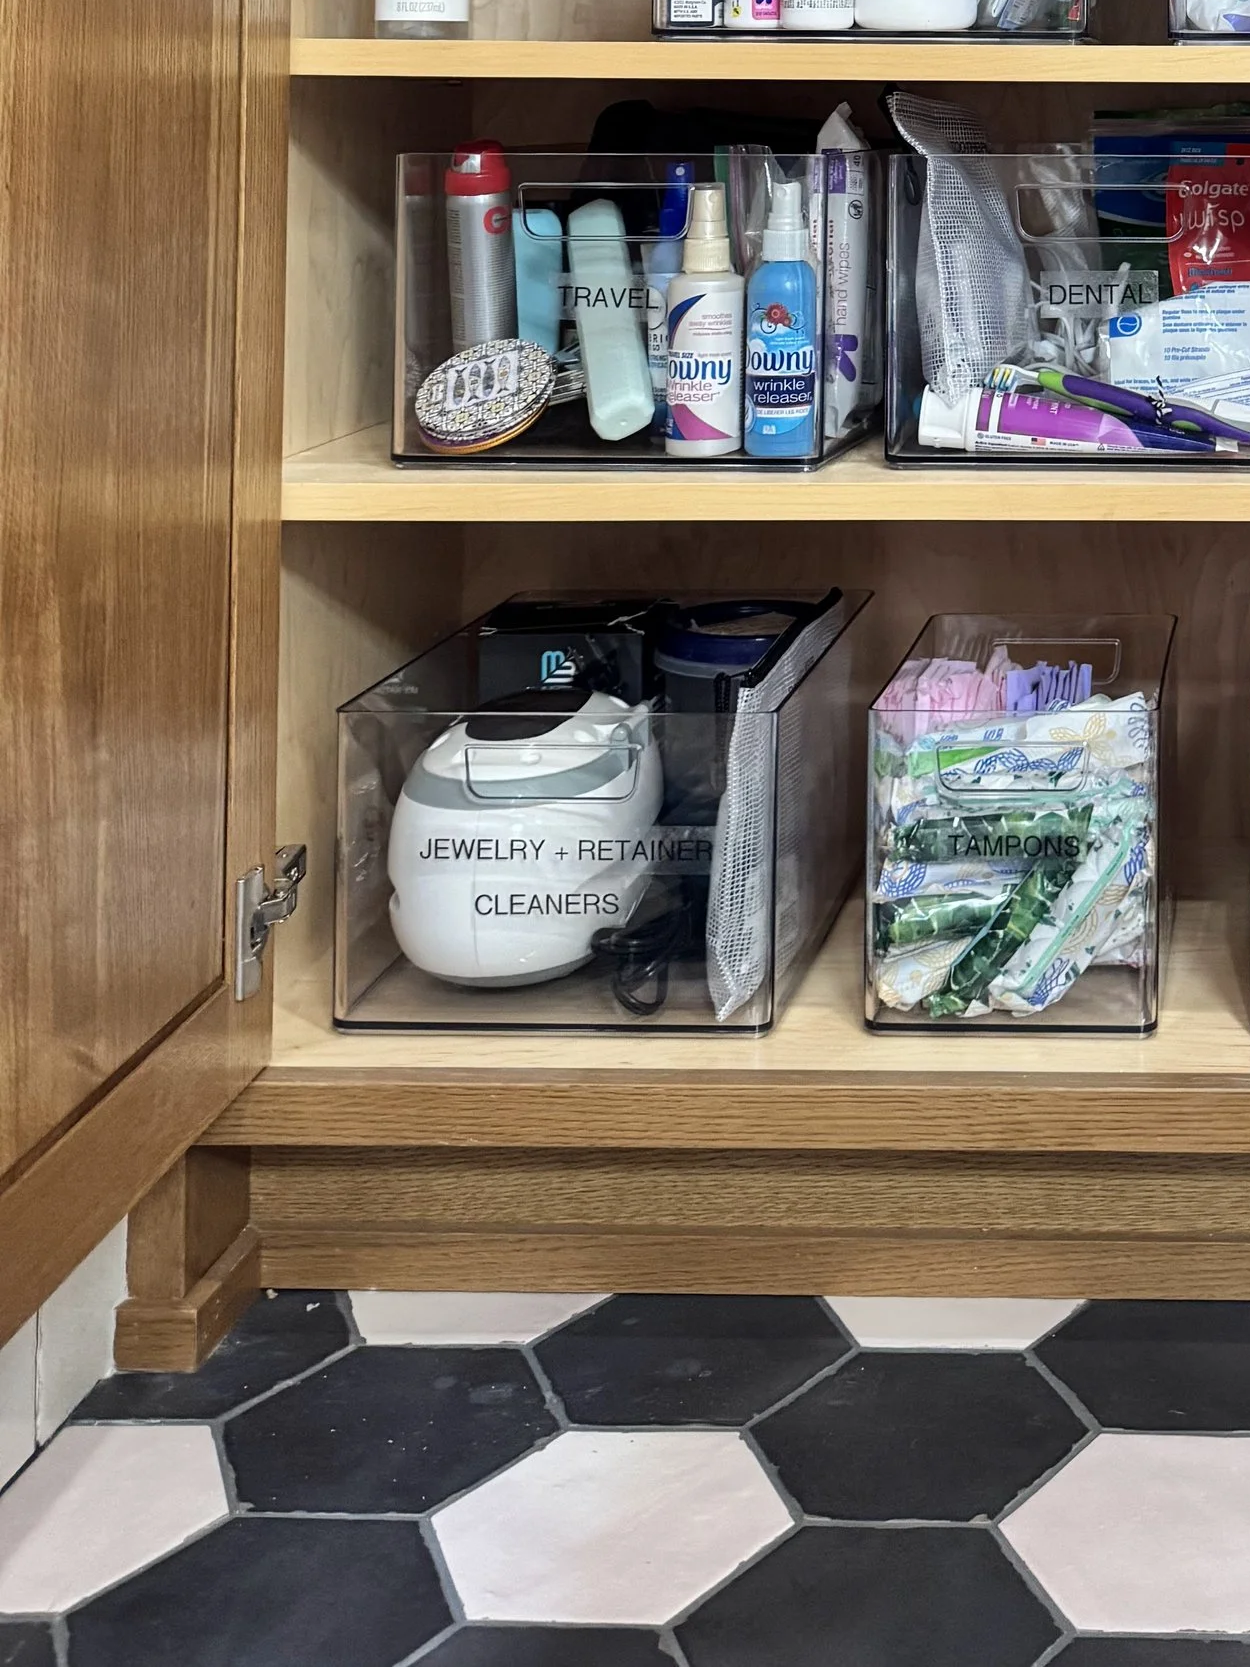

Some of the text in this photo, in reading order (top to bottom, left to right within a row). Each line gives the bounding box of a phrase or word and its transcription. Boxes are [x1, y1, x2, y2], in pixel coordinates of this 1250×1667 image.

[1179, 181, 1249, 198] Colgate
[834, 242, 852, 327] hand wipes
[1049, 284, 1153, 305] DENTAL
[557, 286, 659, 309] TRAVEL
[669, 359, 732, 385] owny
[753, 378, 806, 391] wrinkle
[667, 392, 717, 403] eleaser
[419, 838, 713, 861] JEWELRY + RETAINER
[948, 834, 1081, 858] TAMPONS
[474, 893, 620, 916] CLEANERS
